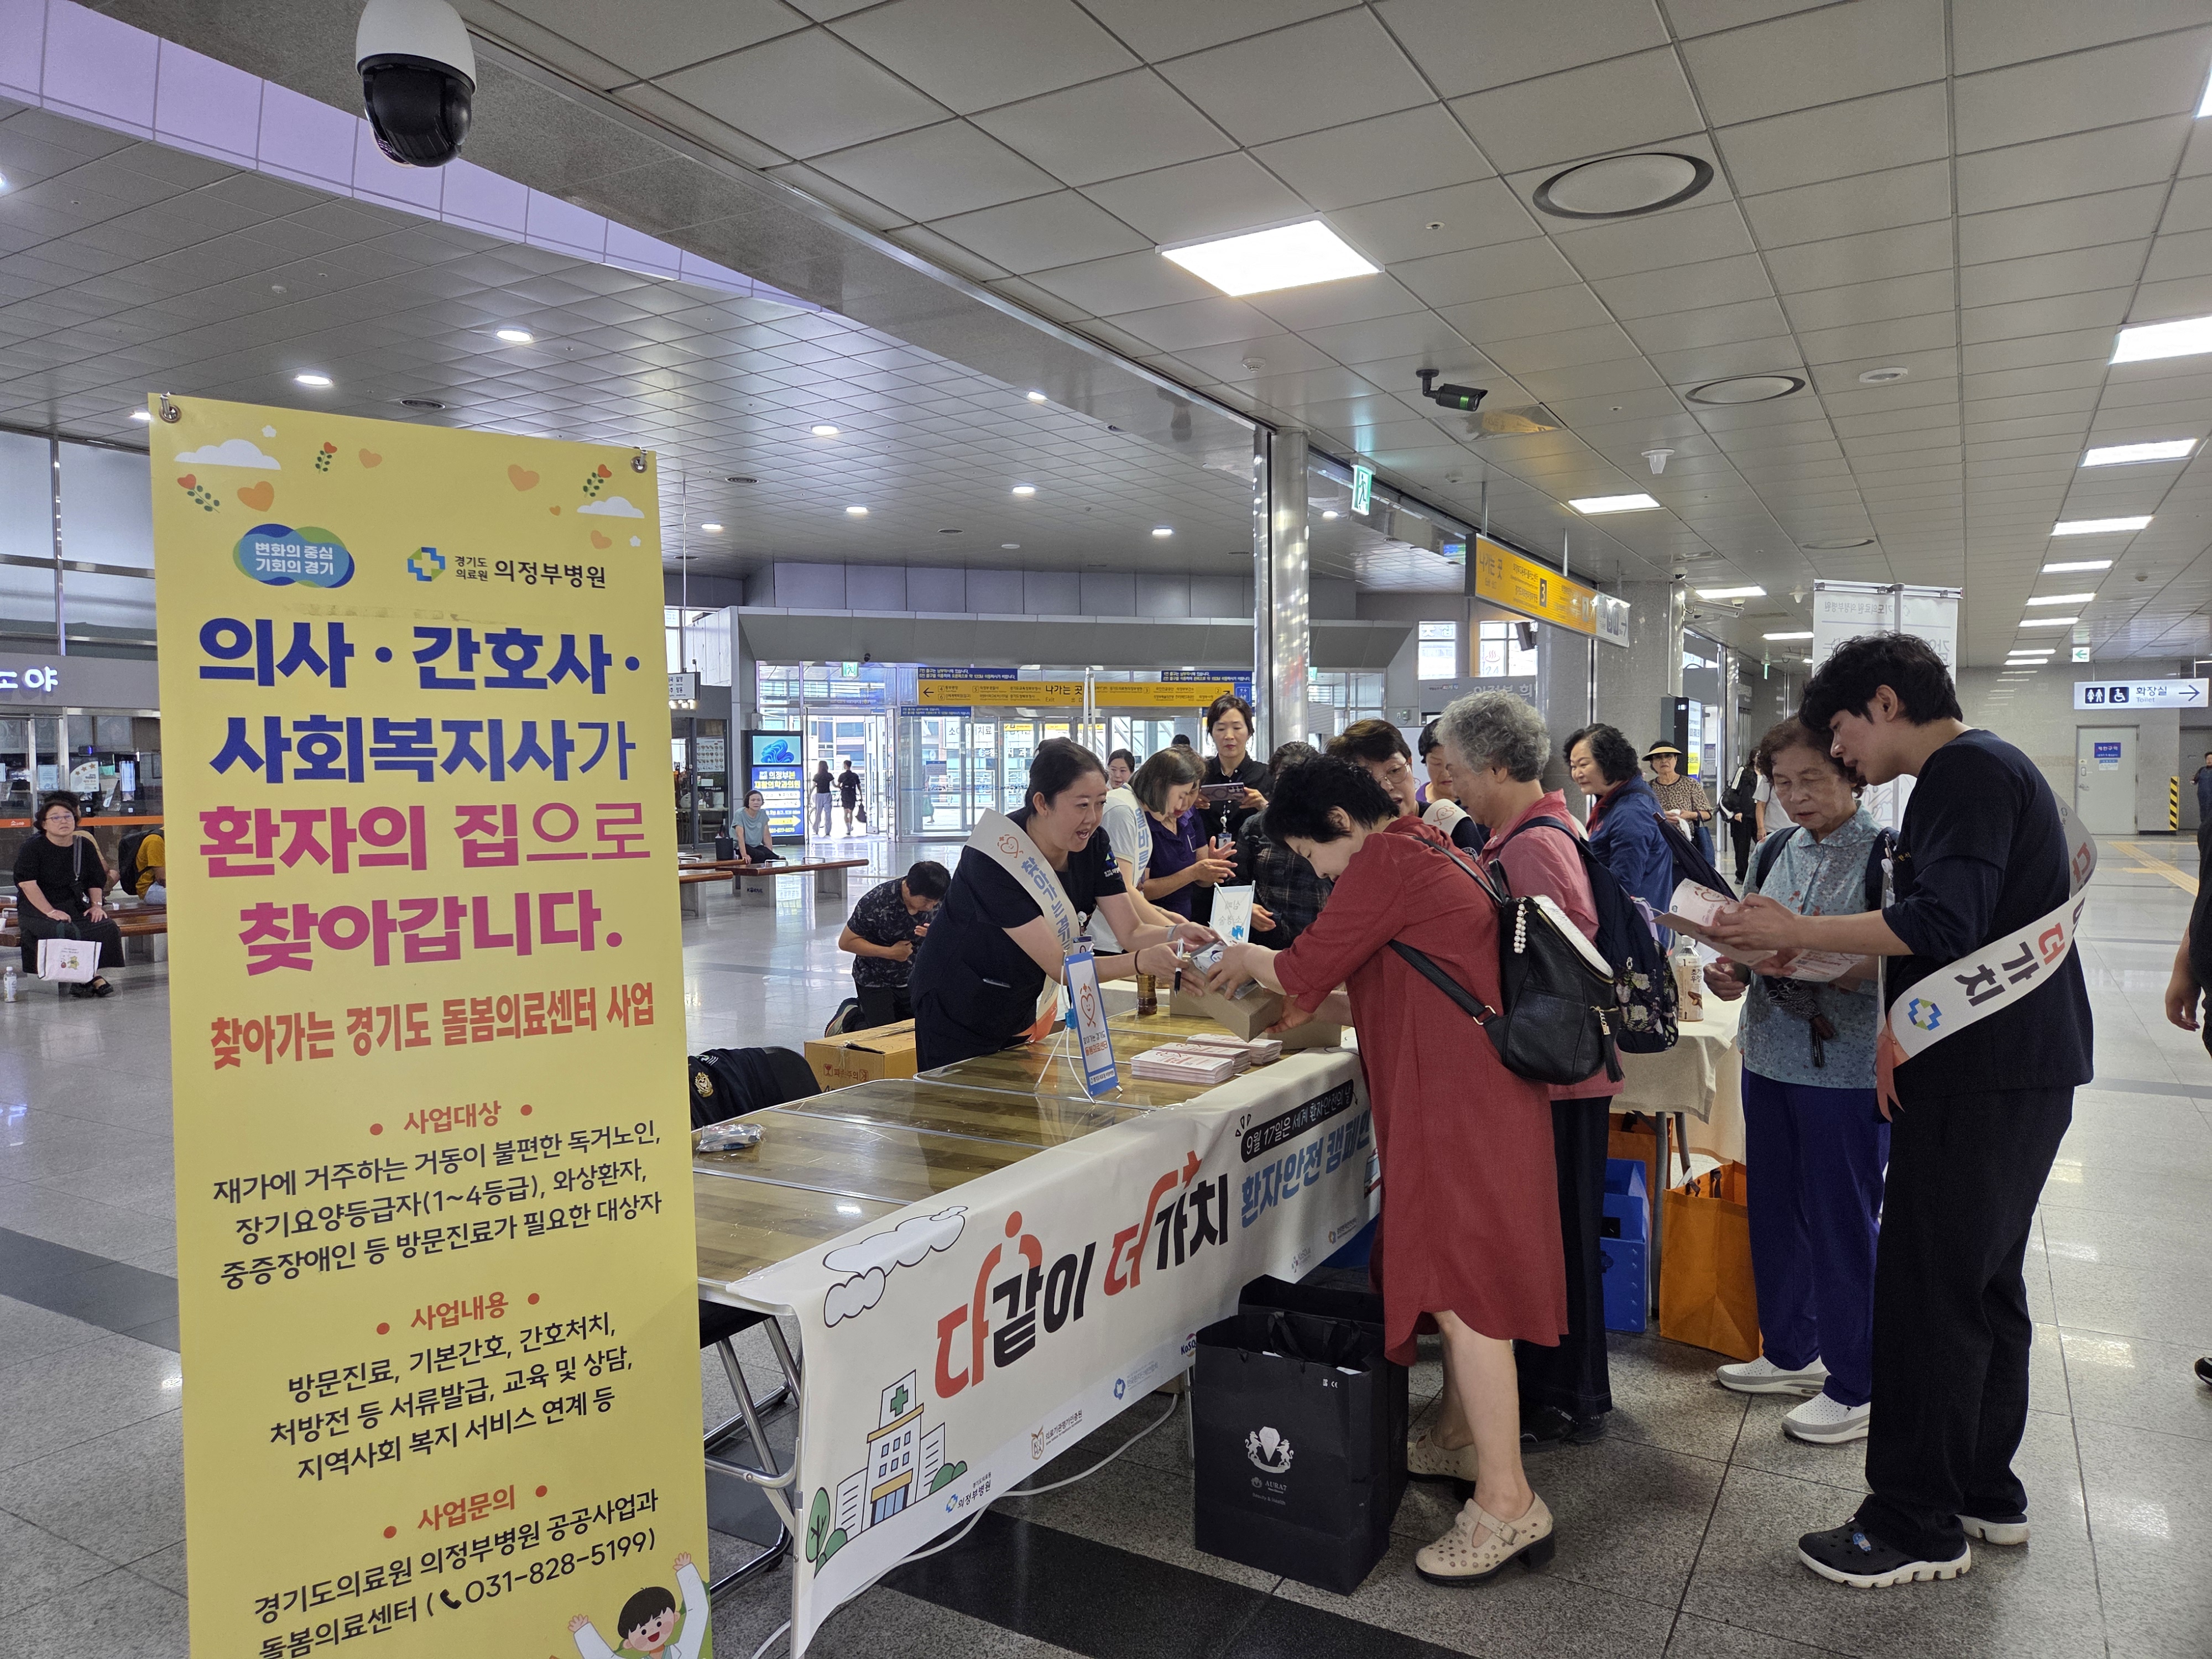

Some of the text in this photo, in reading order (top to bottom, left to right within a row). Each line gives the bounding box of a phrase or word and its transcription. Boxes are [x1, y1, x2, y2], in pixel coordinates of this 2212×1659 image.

[255, 542, 333, 560] 변화의 중심
[256, 558, 333, 575] 기회의 경기
[455, 556, 488, 568] 경기도
[455, 569, 488, 582] 의료원
[494, 560, 607, 589] 의정부병원
[199, 618, 354, 688] 의사
[1045, 685, 1071, 695] 나가는
[1074, 685, 1082, 695] 곳
[2136, 686, 2167, 696] 화장실
[209, 714, 637, 784] 사회복지사가
[199, 802, 651, 878] 환자의 집으로
[1021, 857, 1065, 918] 찾아가는
[238, 889, 623, 976] 찾아갑니다.
[211, 982, 654, 1071] 찾아가는 경기도 돌봄의료센터 사업
[404, 1100, 502, 1135] 사업대상
[1246, 1084, 1352, 1155] 9월 17일은 세계 환자안전의 날
[213, 1120, 661, 1204] 재가에 거주하는 거동이 불편한 독거노인,
[1241, 1136, 1324, 1228] 환자안전
[236, 1158, 646, 1245] 장기요양등급자(1~4등급), 와상환자,
[221, 1191, 662, 1290] 중증장애인 등 방문진료가 필요한 대상자
[410, 1291, 509, 1331] 사업내용
[288, 1312, 616, 1404] 방문진료, 기본간호, 간호처치,
[270, 1345, 633, 1446] 처방전 등 서류발급, 교육 및 상담,
[1045, 1408, 1083, 1440] 의료기관평가인증원
[298, 1386, 615, 1482] 지역사회 복지 서비스 연계 등
[417, 1484, 516, 1533] 사업문의
[957, 1479, 991, 1509] 의정부병원
[1265, 1480, 1287, 1491] AURA7
[254, 1488, 658, 1624] 경기도의료원 의정부병원 공공사업과
[259, 1596, 418, 1659] 돌봄의료센터
